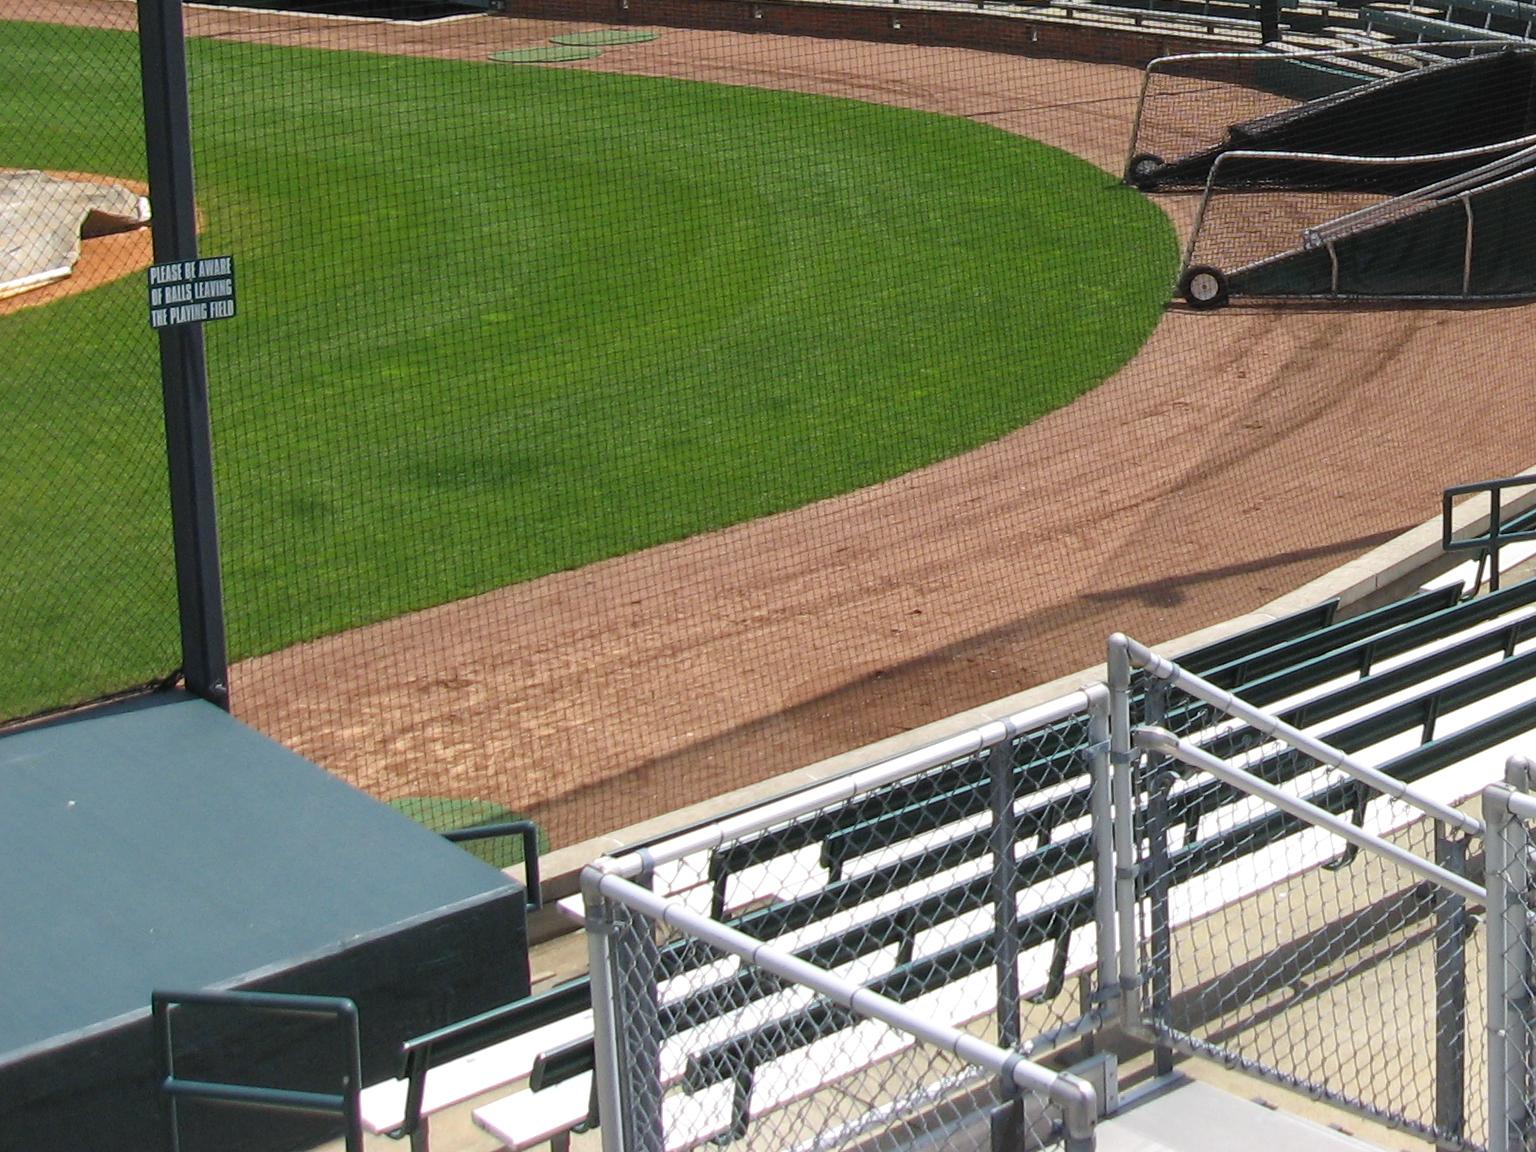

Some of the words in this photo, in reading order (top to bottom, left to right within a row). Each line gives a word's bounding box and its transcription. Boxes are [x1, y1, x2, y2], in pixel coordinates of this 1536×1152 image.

[150, 263, 182, 285] PLEASE
[184, 261, 196, 280] BE
[198, 257, 232, 278] AWARE
[151, 288, 163, 306] OF
[164, 283, 192, 304] BALLS
[194, 278, 232, 300] LEAVING
[151, 308, 168, 328] THE
[169, 302, 208, 325] PLAYING
[209, 299, 235, 319] FIELD
